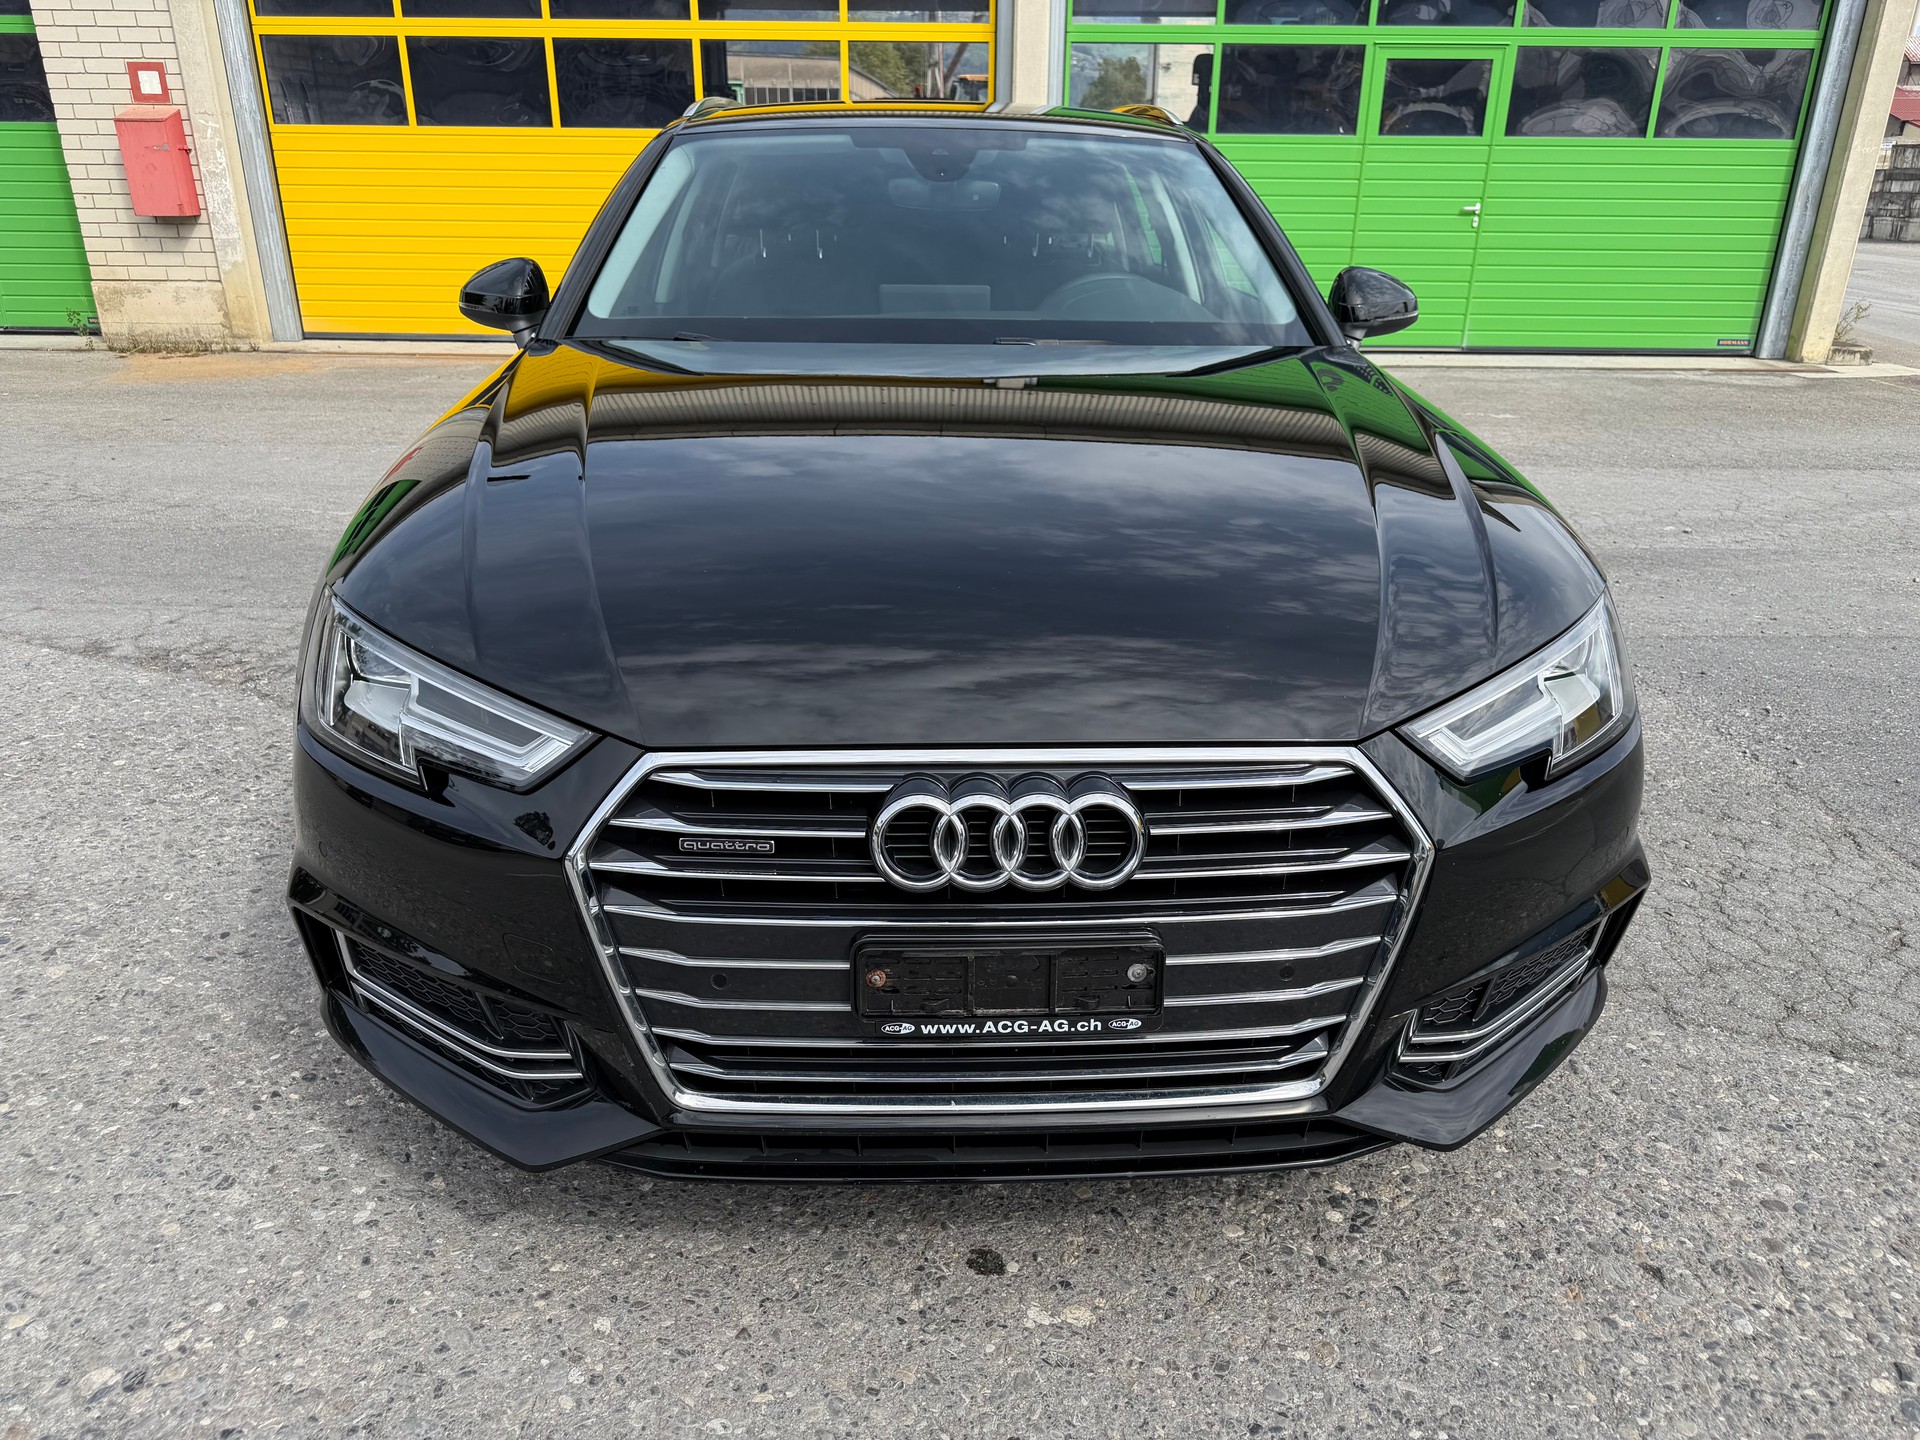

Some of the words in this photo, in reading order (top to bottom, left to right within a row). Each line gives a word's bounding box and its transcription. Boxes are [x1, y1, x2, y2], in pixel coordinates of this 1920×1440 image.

[683, 841, 770, 851] quattro
[883, 1024, 914, 1032] ACG-AG
[920, 1019, 1102, 1034] www.ACG-AG.ch
[1110, 1019, 1140, 1028] ACG-AG
